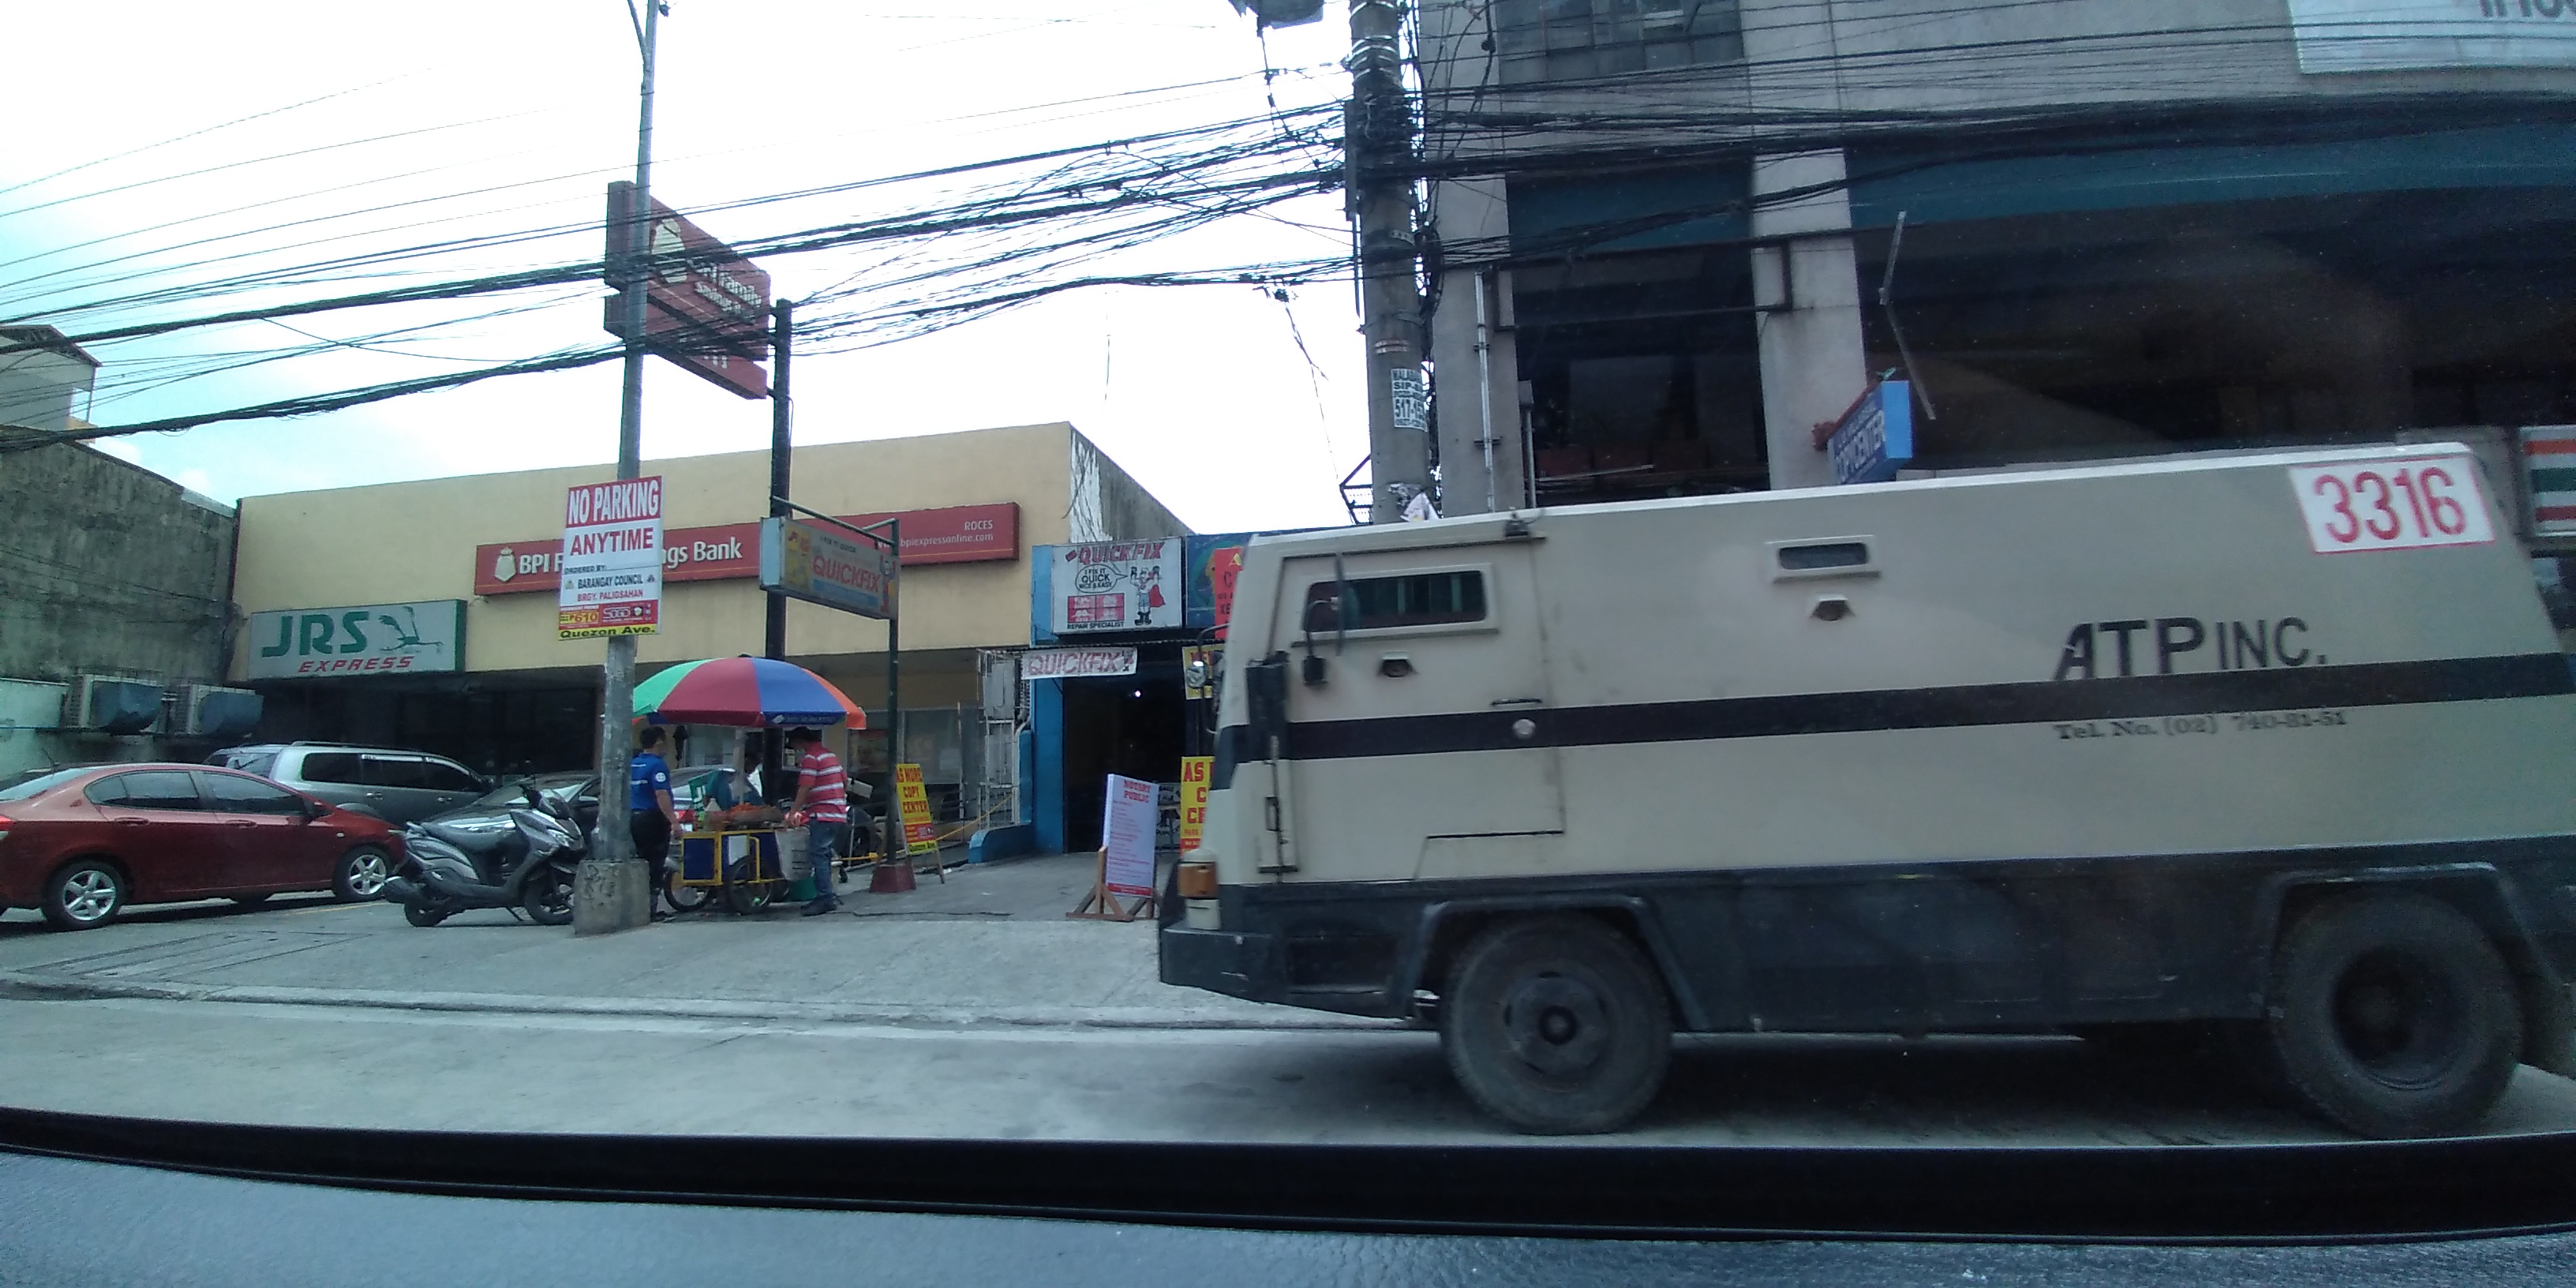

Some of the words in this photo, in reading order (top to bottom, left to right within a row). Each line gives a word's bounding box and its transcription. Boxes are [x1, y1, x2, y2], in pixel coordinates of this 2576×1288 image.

[567, 490, 590, 525] NO
[593, 479, 660, 522] PARKING
[2313, 466, 2466, 544] 3316
[964, 519, 994, 532] ROCES
[570, 526, 654, 556] ANYTIME
[519, 554, 550, 575] BPI
[694, 535, 744, 563] Bank
[1079, 541, 1165, 566] QUICKFIX
[564, 564, 596, 575] ORDERED
[813, 554, 881, 593] QUICKFIX
[1081, 574, 1111, 583] QUICK
[577, 577, 612, 590] BARANGAY
[613, 574, 644, 586] COUNCIL
[260, 609, 371, 658] JRS
[560, 627, 616, 639] Quezon
[620, 623, 656, 636] Ave.
[1089, 620, 1125, 629] SPECIALIST
[2053, 616, 2207, 681] ATP
[2215, 616, 2327, 672] INC.
[298, 655, 415, 673] EXPRESS
[1026, 652, 1121, 676] QUICKFIX
[2054, 723, 2103, 740] Tel.
[2111, 720, 2157, 737] No.
[2165, 714, 2218, 736] (02)
[903, 786, 920, 799] COPY
[902, 800, 928, 814] CENTER
